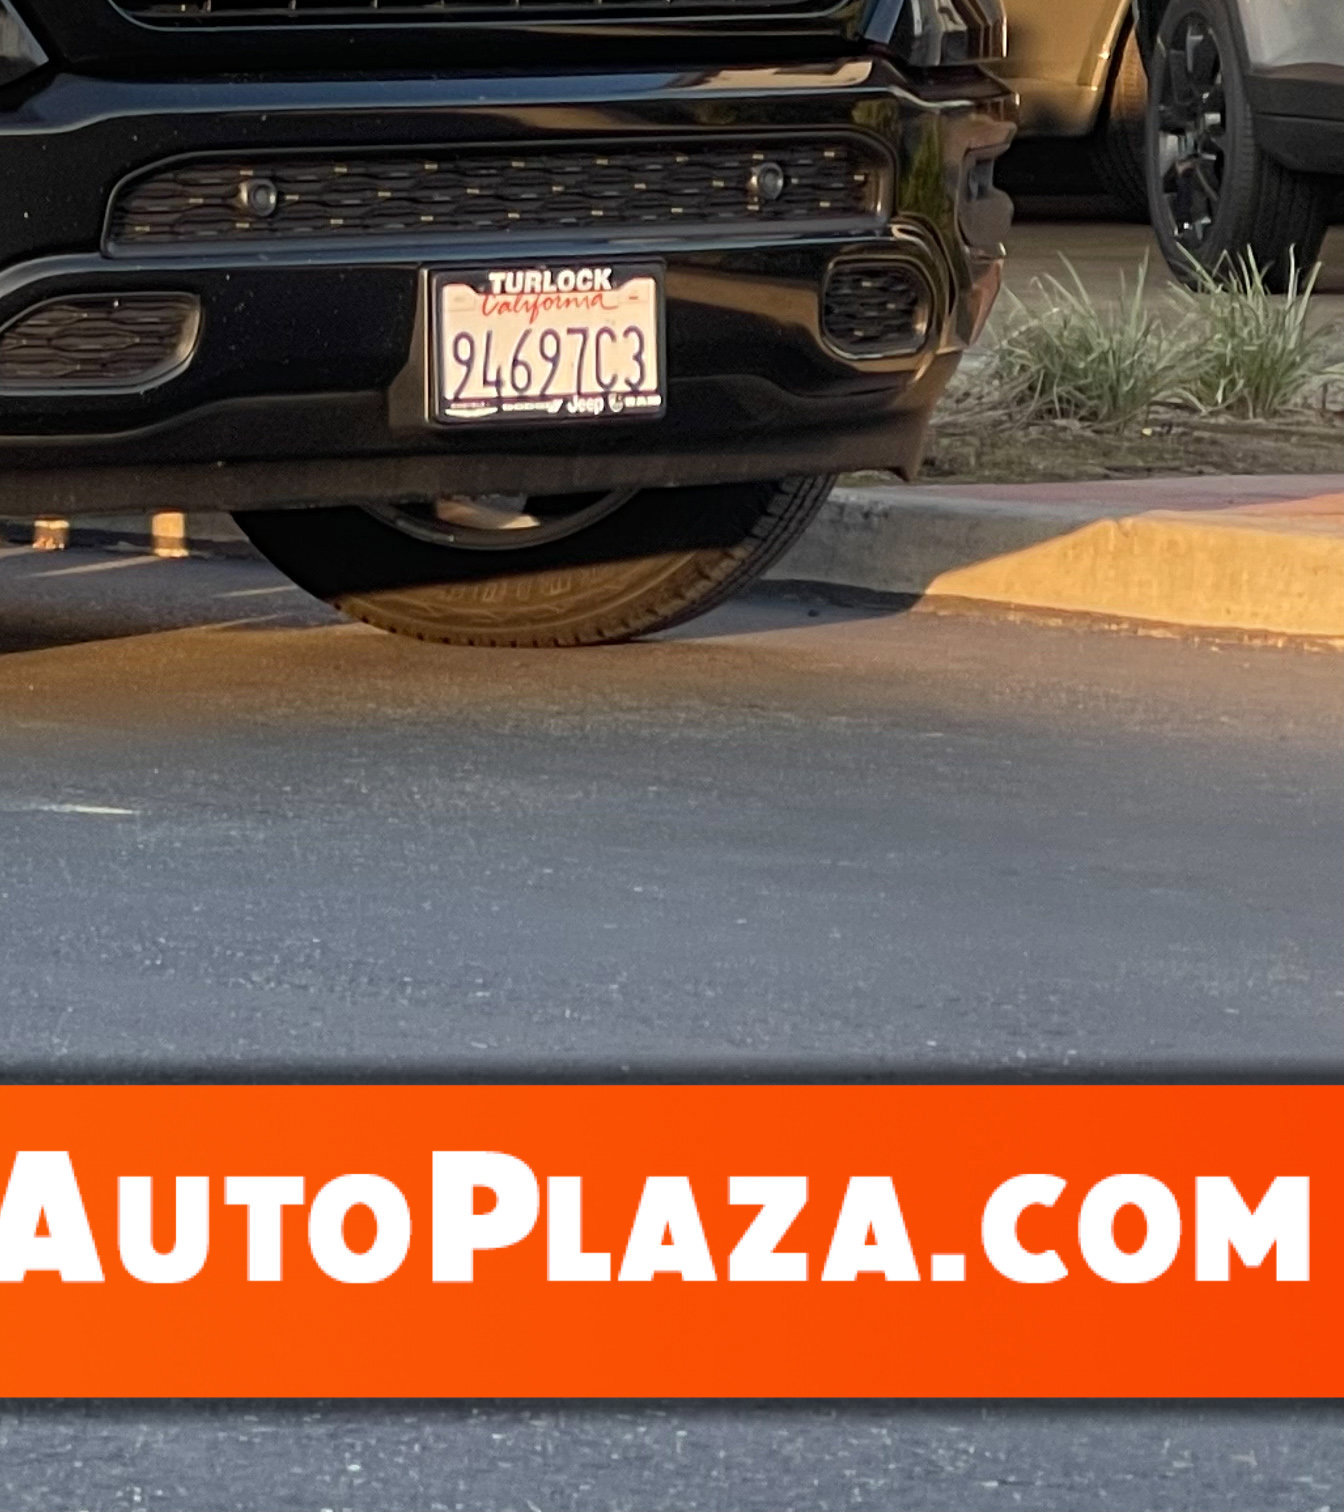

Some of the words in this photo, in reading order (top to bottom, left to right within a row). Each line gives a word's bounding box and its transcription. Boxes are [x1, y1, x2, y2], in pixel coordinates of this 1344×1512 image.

[488, 268, 613, 294] TURLOCK
[481, 291, 618, 324] California
[452, 325, 646, 398] 94697C3
[567, 394, 605, 415] Jeep
